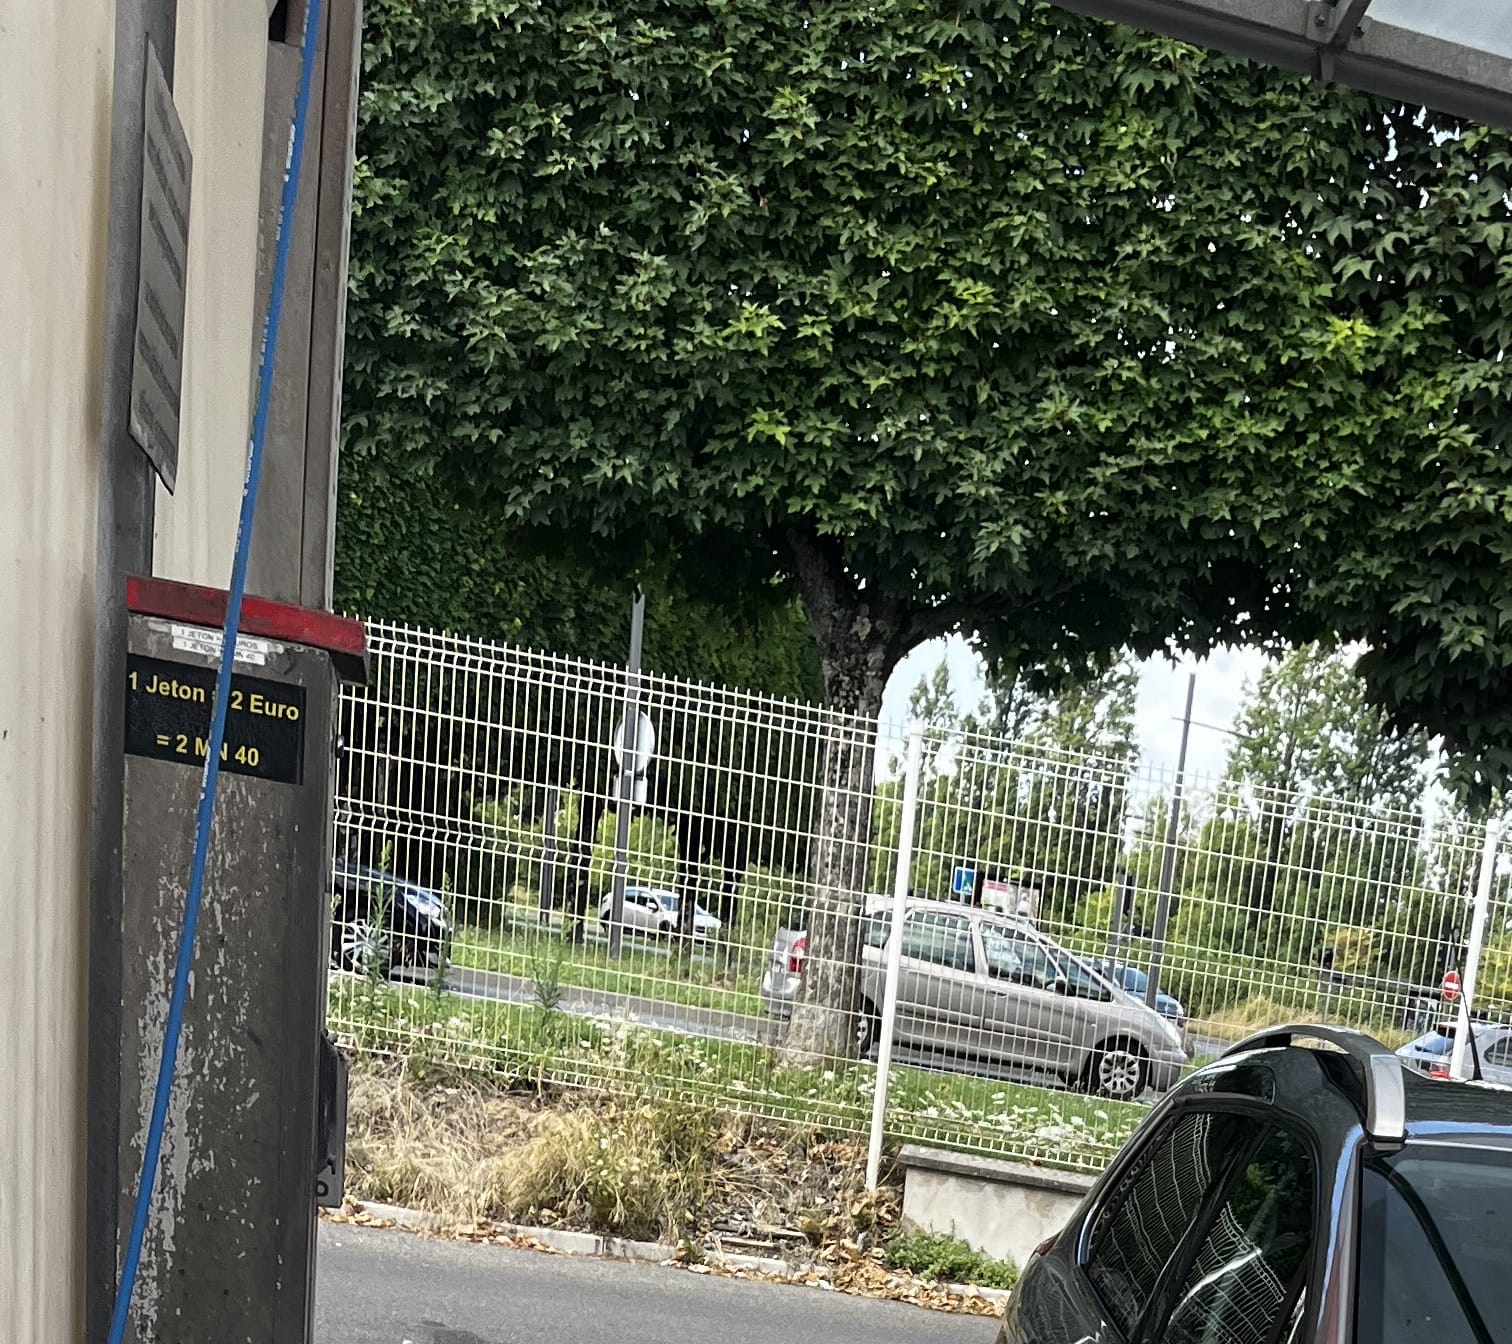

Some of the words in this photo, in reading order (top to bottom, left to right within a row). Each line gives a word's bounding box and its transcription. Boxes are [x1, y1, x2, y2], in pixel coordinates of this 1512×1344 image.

[128, 671, 138, 691] 1
[145, 675, 205, 703] Jeton
[231, 690, 243, 710] 2
[249, 693, 299, 721] Euro
[176, 734, 188, 754] 2
[234, 745, 260, 767] 40
